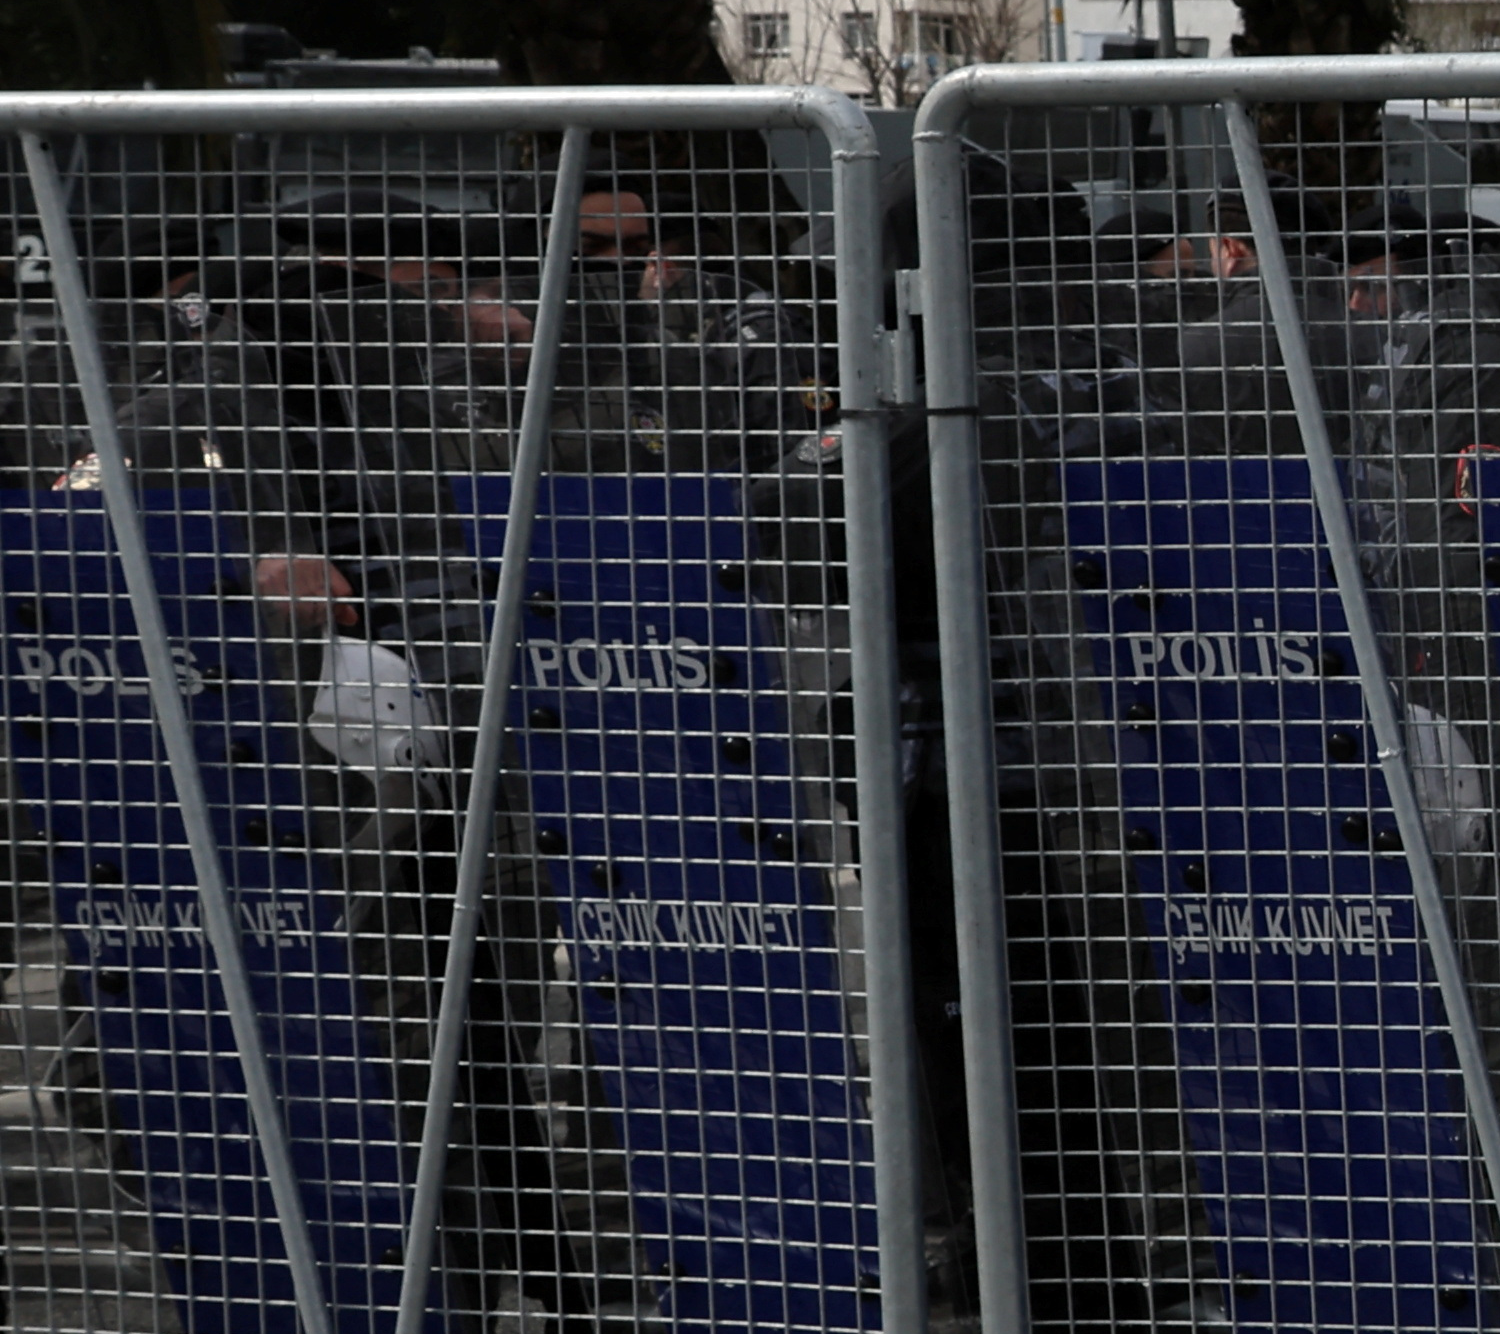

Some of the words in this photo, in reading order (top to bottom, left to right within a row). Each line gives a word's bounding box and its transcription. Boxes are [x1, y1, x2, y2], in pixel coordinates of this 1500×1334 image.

[16, 645, 204, 696] POLS
[527, 624, 708, 689] POLİS
[1129, 617, 1316, 679] POLİS
[576, 891, 667, 963] ÇEVİK
[1164, 895, 1261, 965] ÇEVİK
[1264, 904, 1394, 957] KUVVET
